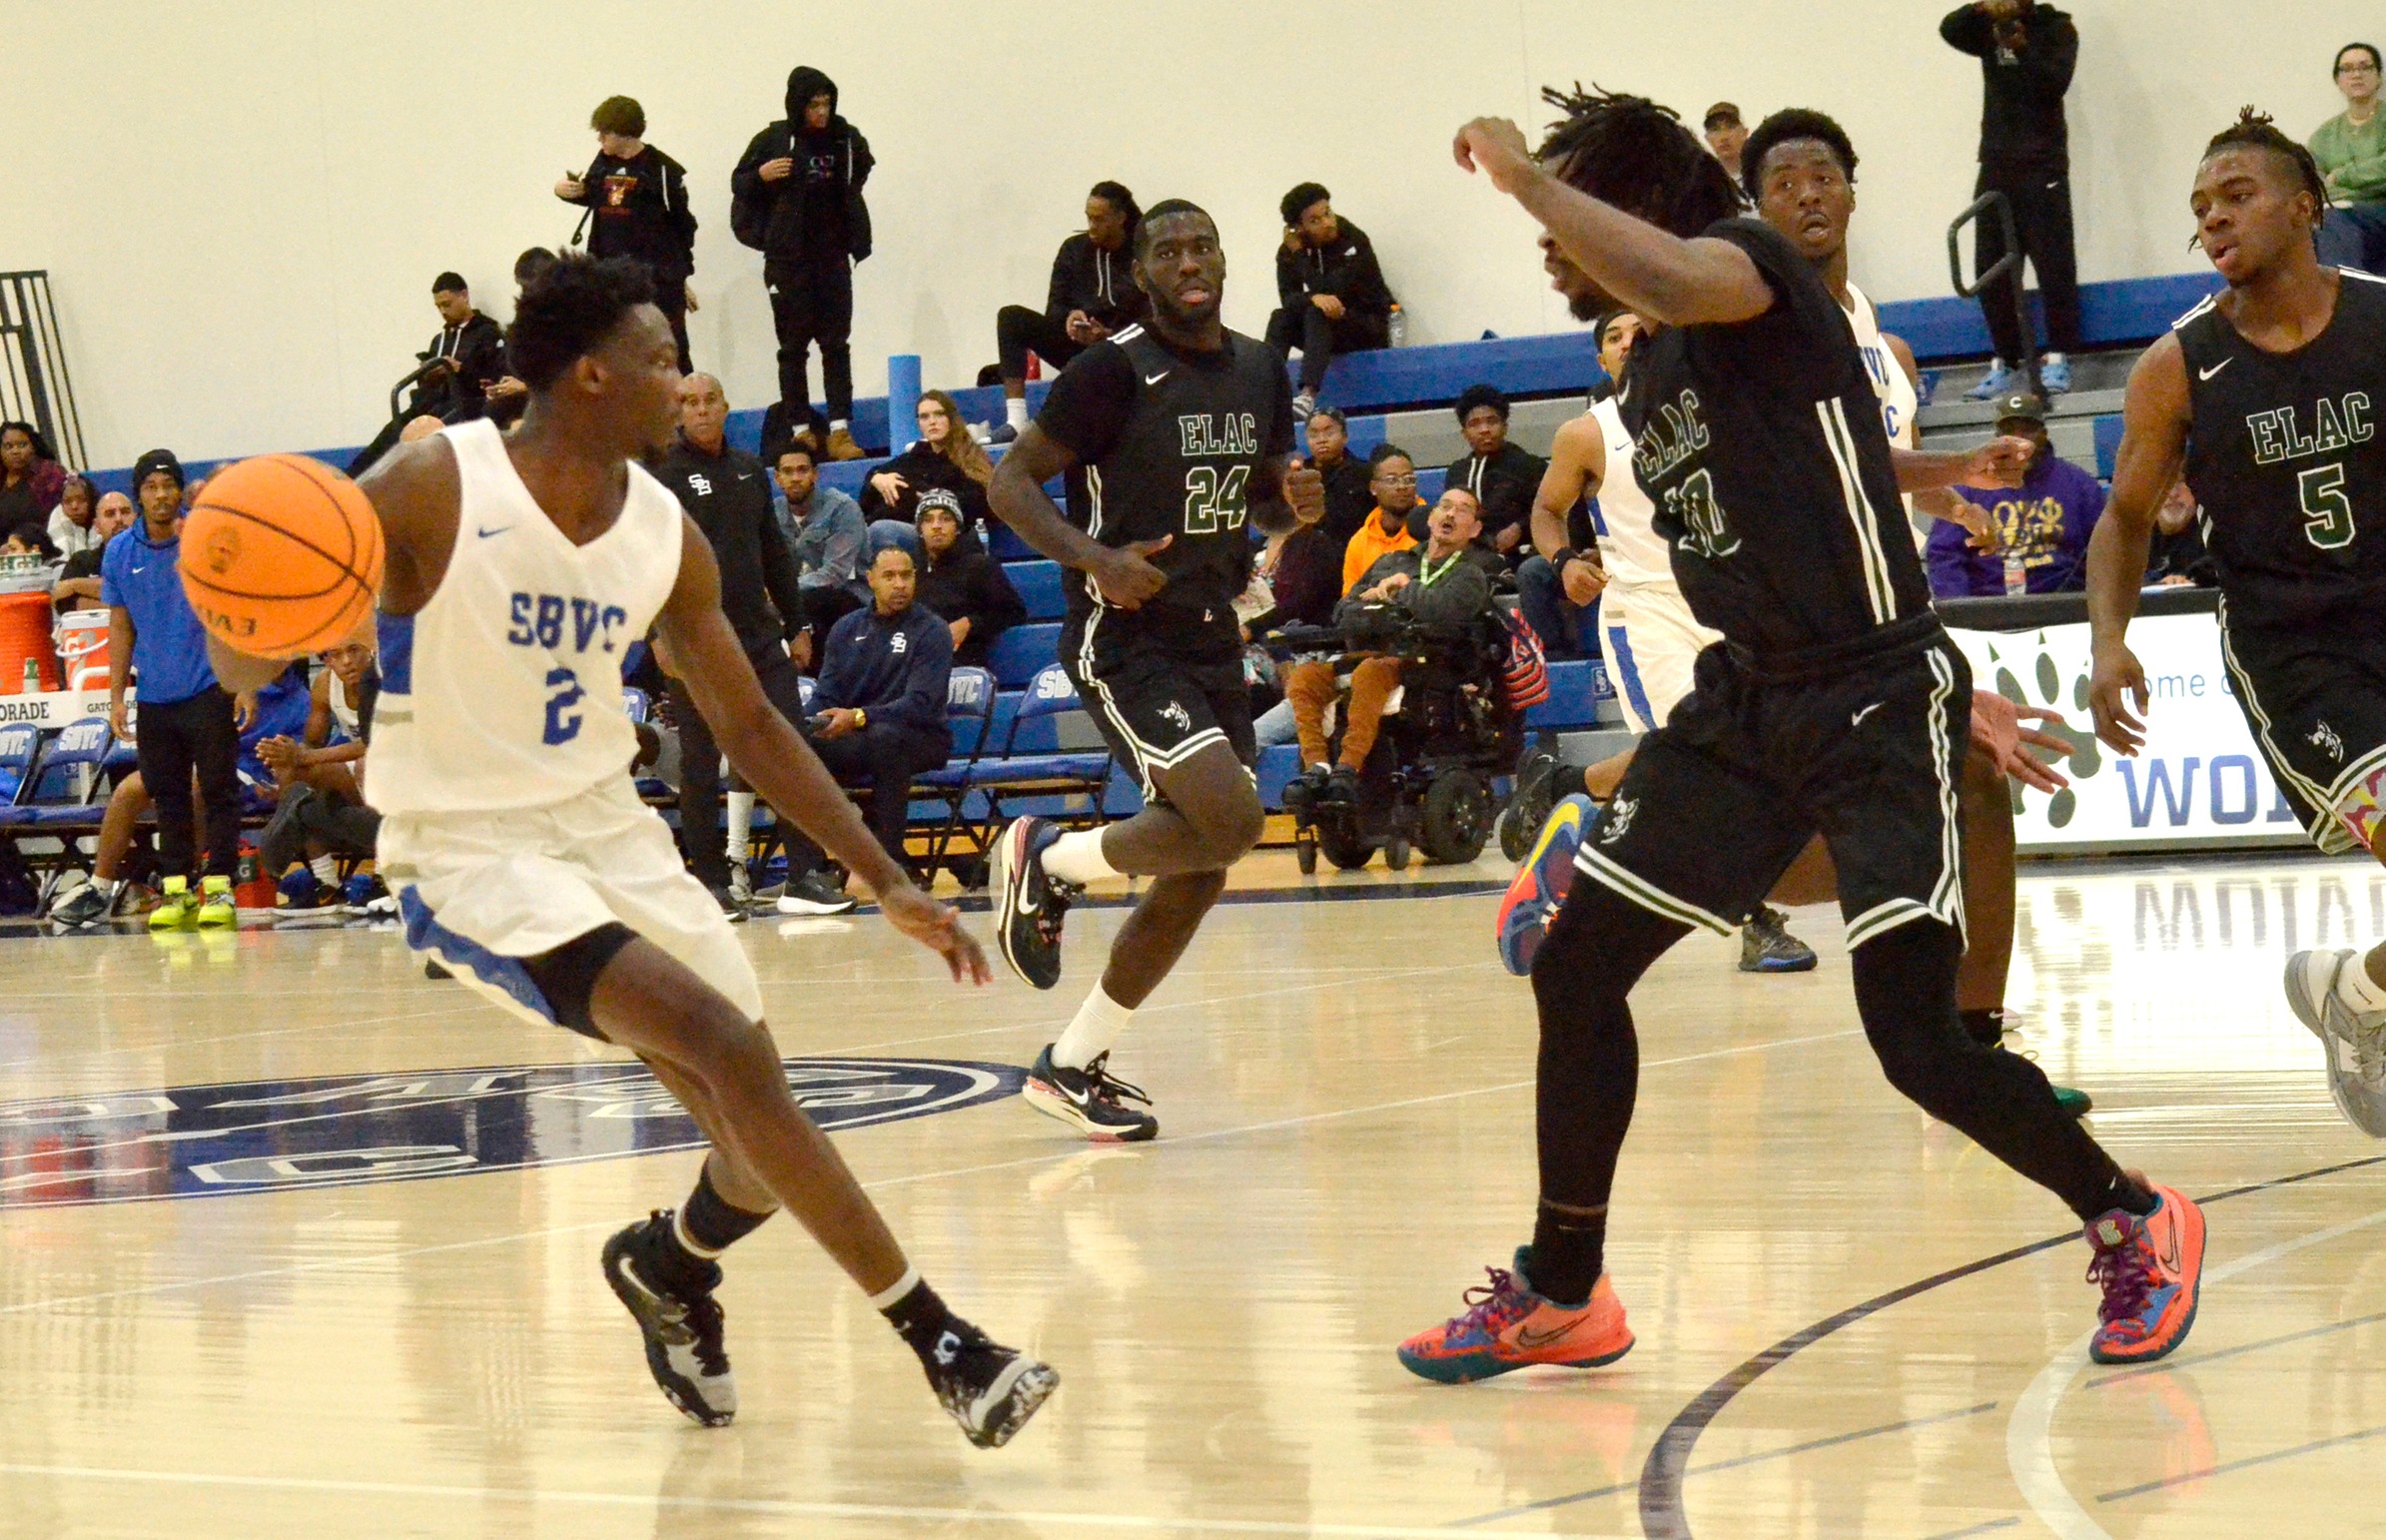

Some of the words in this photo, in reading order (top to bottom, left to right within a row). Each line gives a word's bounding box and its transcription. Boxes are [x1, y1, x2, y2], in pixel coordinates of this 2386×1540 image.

[1179, 412, 1257, 455] ELAC
[2246, 390, 2374, 464] ELAC
[1185, 465, 1250, 533] 24
[2297, 462, 2356, 549] 5
[508, 592, 626, 653] SBVC
[543, 666, 586, 745] 2
